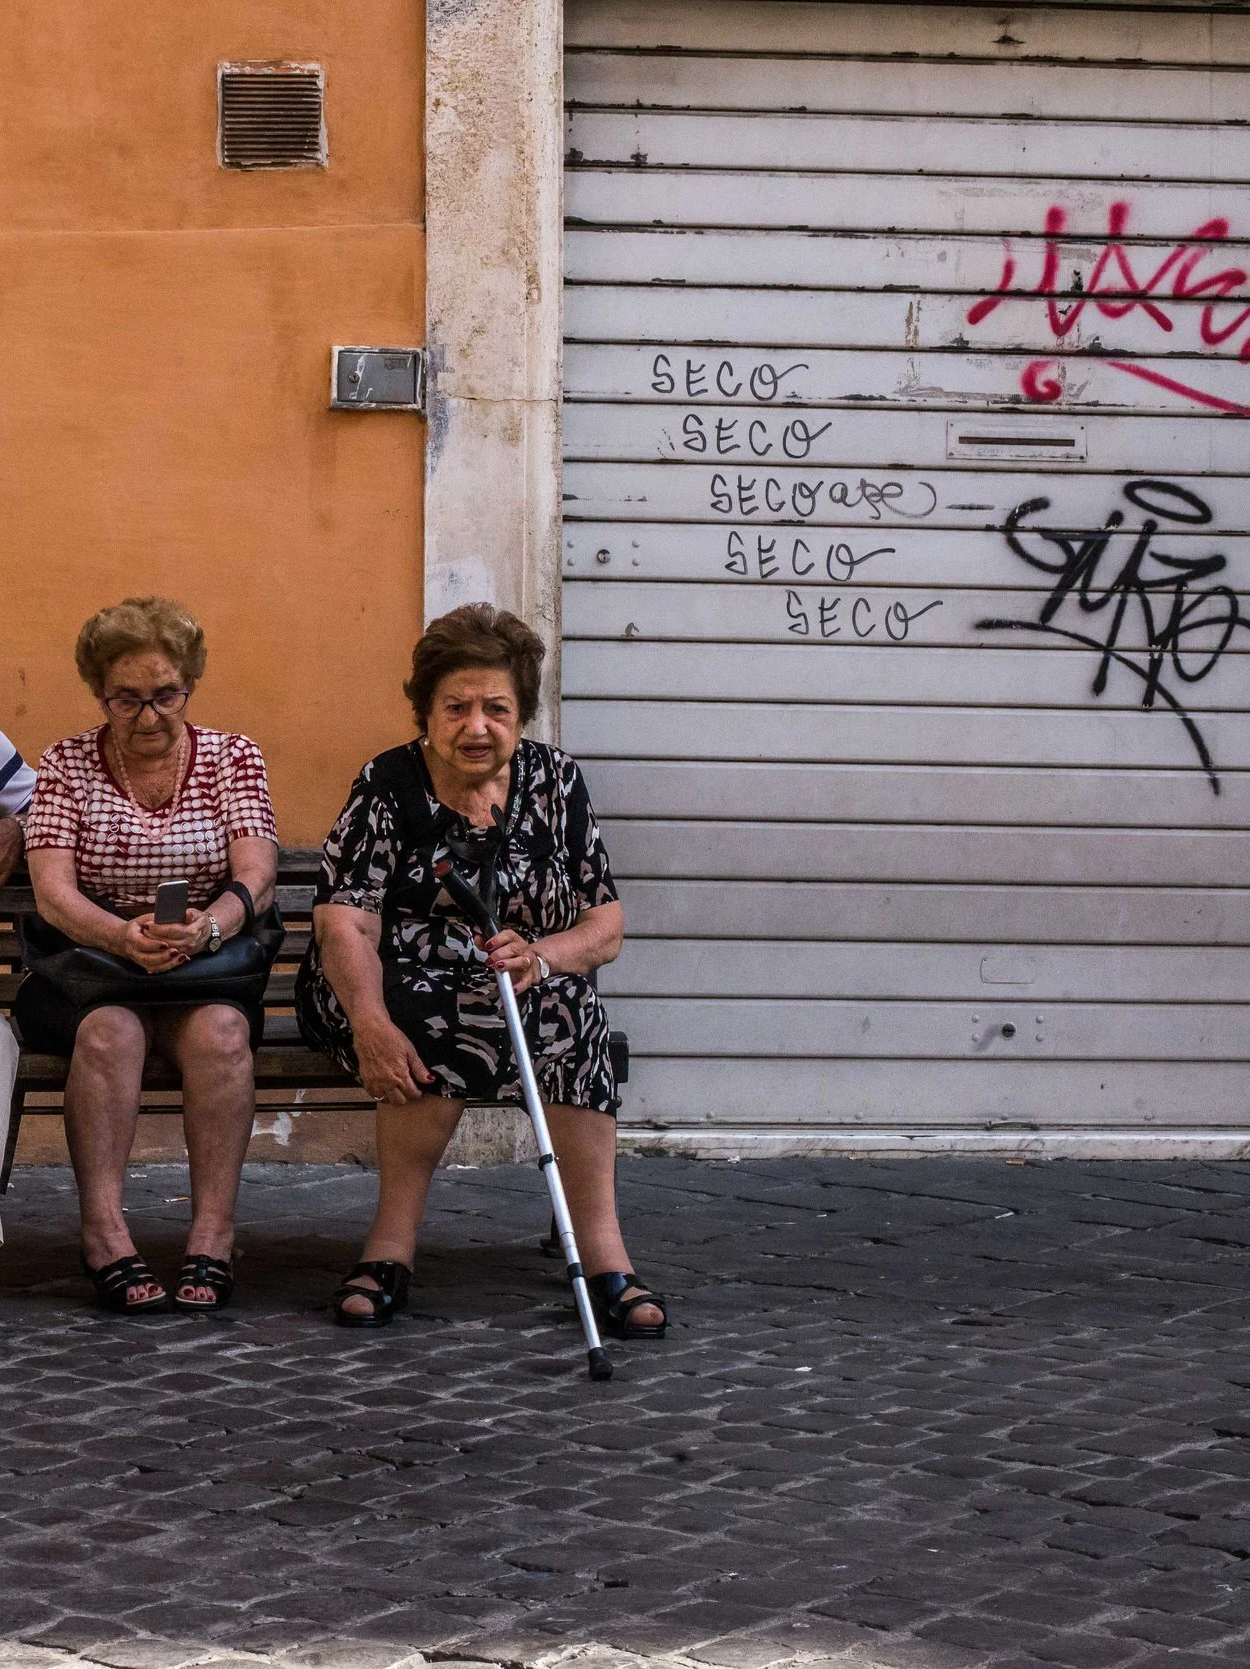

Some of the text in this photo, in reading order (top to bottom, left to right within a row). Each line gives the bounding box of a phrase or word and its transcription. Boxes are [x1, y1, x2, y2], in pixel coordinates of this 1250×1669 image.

[651, 353, 810, 401] SECO
[682, 413, 833, 459] SECO
[725, 530, 896, 582] SECO
[785, 589, 944, 641] SECO
